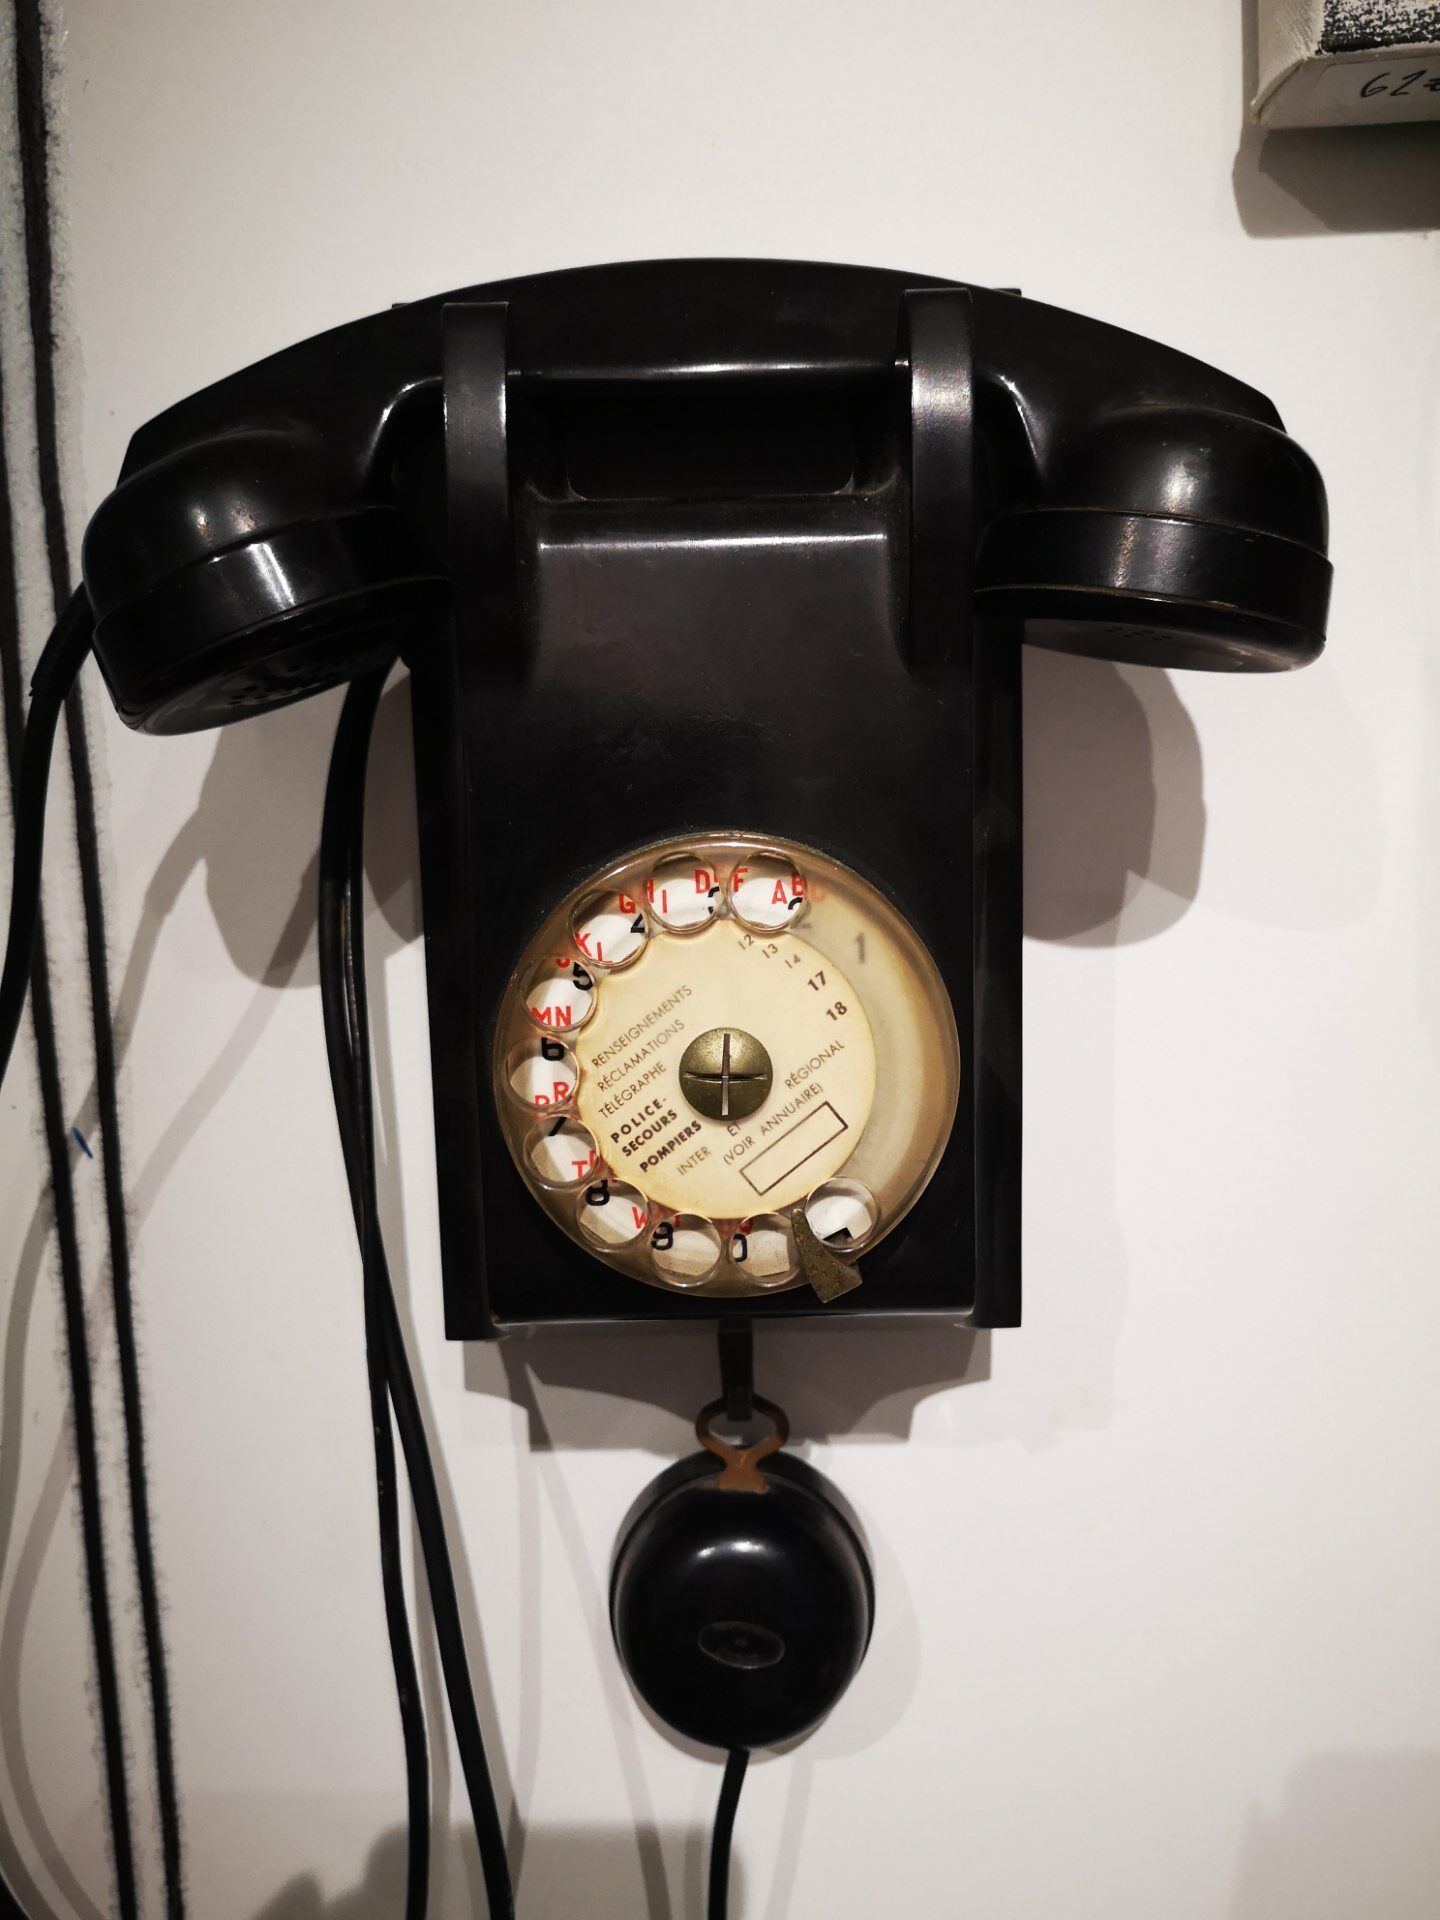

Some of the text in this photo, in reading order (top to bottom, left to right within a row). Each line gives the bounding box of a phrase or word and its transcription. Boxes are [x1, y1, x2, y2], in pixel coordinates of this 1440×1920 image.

[573, 961, 594, 991] 5
[591, 934, 754, 1068] RENSEIGNEMENTS 12
[597, 943, 778, 1092] RÉCLAMATIONS 13
[598, 953, 801, 1118] TÉLÉGRAPHE 14
[541, 1036, 565, 1061] 6
[621, 970, 826, 1157] SECOURS 17
[639, 1120, 702, 1173] POMPIERS
[826, 1001, 848, 1020] 18
[676, 1145, 711, 1176] INTER
[784, 1040, 845, 1089] RÉGIONAL
[610, 1097, 666, 1144] POLICE-
[723, 1083, 824, 1165] (VOIR ANNUAIRE)
